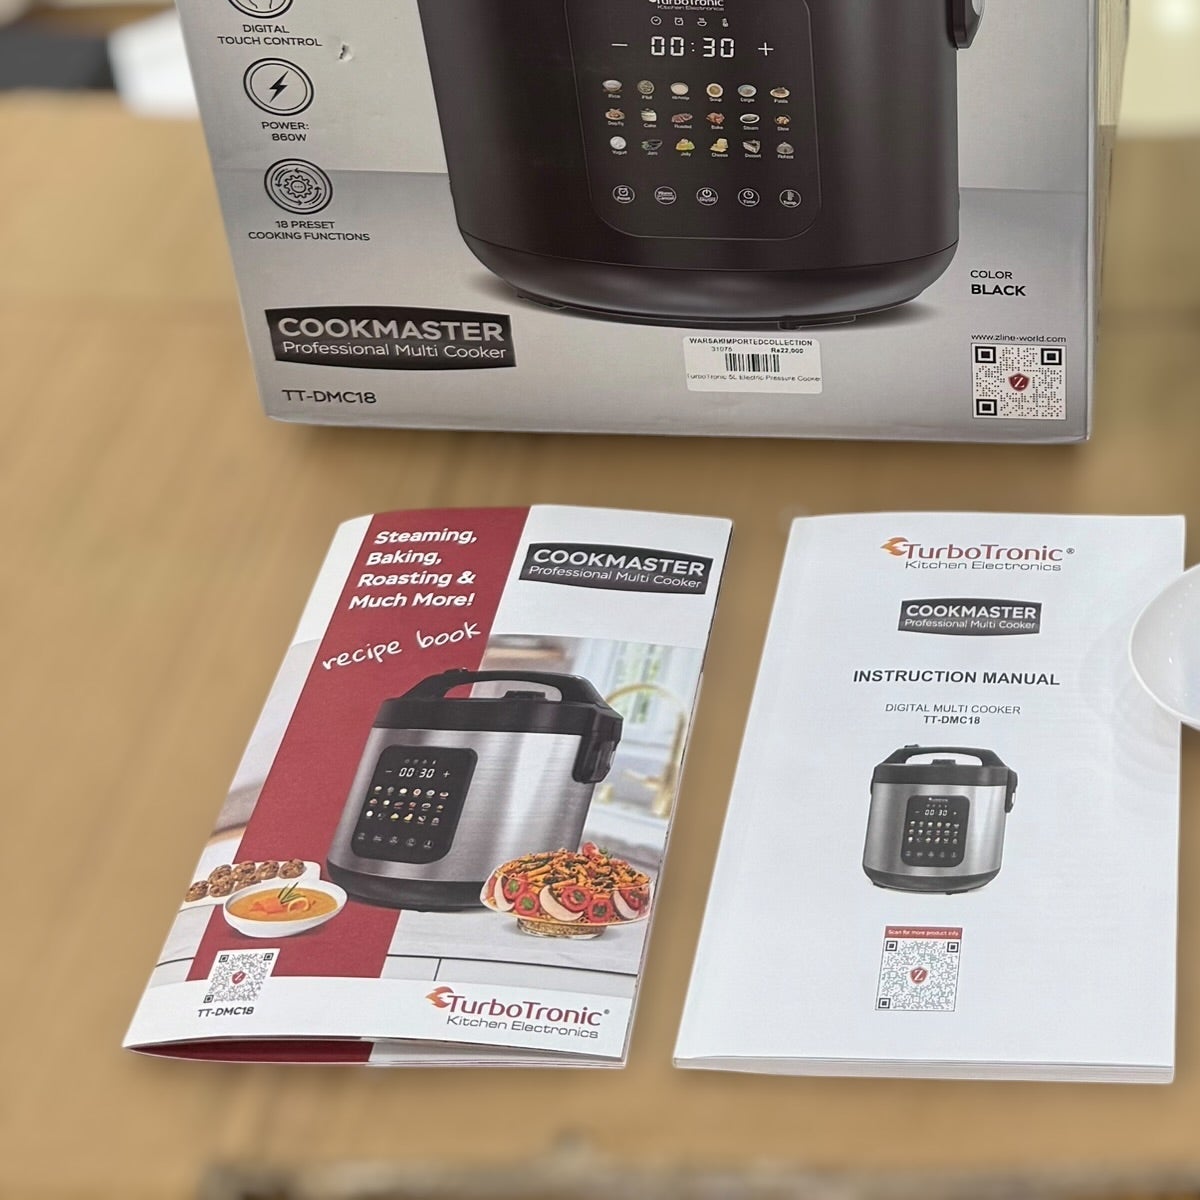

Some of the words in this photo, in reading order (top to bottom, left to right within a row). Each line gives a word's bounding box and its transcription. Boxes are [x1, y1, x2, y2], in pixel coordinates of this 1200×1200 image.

[242, 24, 290, 34] DIGITAL
[217, 36, 261, 45] TOUCH
[263, 36, 323, 46] CONTROL
[261, 121, 309, 131] POWER:
[271, 133, 307, 142] 860W
[275, 221, 289, 229] 18
[290, 221, 335, 230] PRESET
[248, 232, 302, 241] COOKING
[304, 232, 371, 241] FUNCTIONS
[970, 270, 1013, 280] COLOR
[971, 284, 1027, 297] BLACK
[277, 317, 505, 342] COOKMASTER
[282, 341, 390, 356] Professional
[395, 344, 438, 358] Multi
[443, 345, 506, 359] Cooker
[281, 389, 377, 404] TT-DMC18
[374, 529, 478, 545] Steaming,
[366, 550, 442, 567] Baking,
[533, 549, 706, 577] COOKMASTER
[904, 560, 968, 570] Kitchen
[972, 561, 1062, 572] Electronics
[357, 570, 453, 588] Roasting
[456, 570, 476, 585] &
[528, 565, 612, 580] Professional
[615, 571, 650, 584] Multi
[653, 575, 703, 589] Cooker
[348, 593, 407, 610] Much
[412, 593, 474, 607] More!
[905, 604, 1037, 619] COOKMASTER
[904, 618, 968, 629] Professional
[970, 619, 996, 629] Multi
[999, 620, 1036, 630] Cooker
[322, 638, 403, 672] recipe
[416, 621, 481, 649] book
[853, 669, 977, 683] INSTRUCTION
[982, 671, 1060, 686] MANUAL
[885, 703, 930, 713] DIGITAL
[933, 704, 968, 713] MULTI
[970, 704, 1021, 714] COOKER
[923, 715, 981, 725] TT-DMC18
[197, 1006, 255, 1018] TT-DMC18
[446, 1015, 508, 1030] Kitchen
[511, 1021, 599, 1039] Electronics
